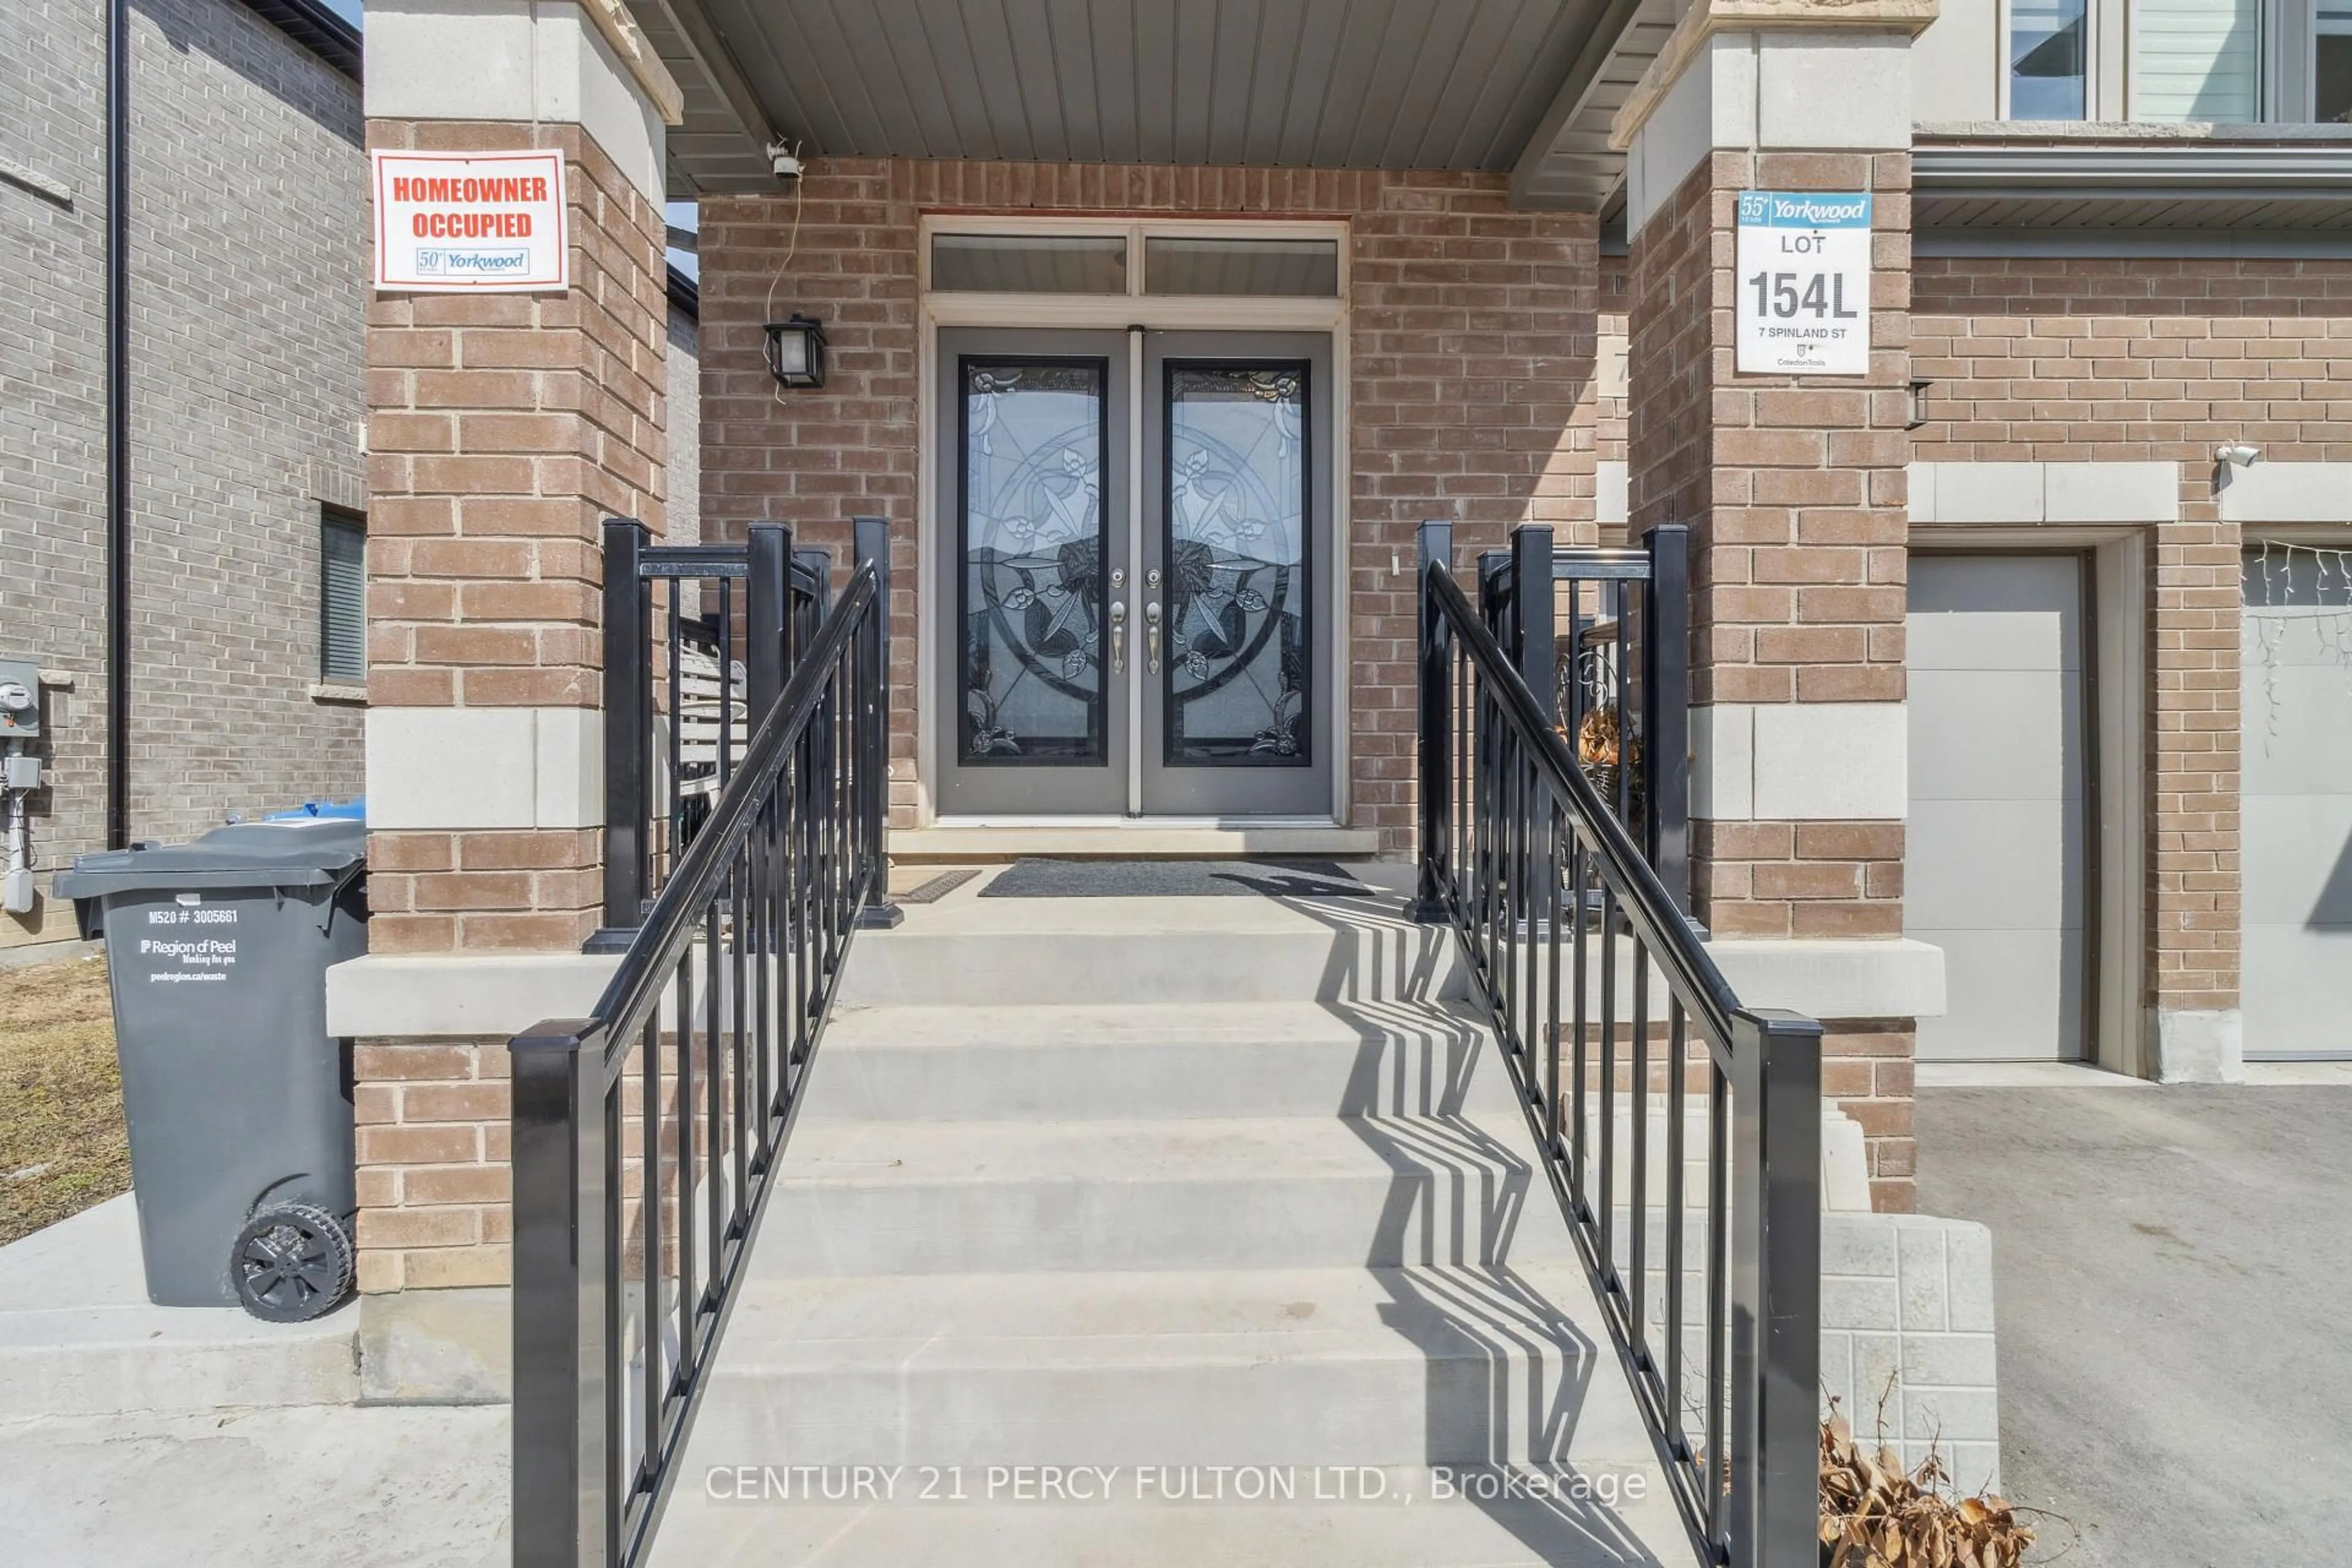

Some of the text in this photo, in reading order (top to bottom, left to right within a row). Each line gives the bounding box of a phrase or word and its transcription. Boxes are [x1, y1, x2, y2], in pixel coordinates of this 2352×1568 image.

[393, 177, 548, 202] HOMEOWNER
[1774, 200, 1866, 224] Yorkwood
[413, 213, 532, 238] OCCUPIED
[1782, 235, 1826, 254] LOT
[449, 254, 524, 271] Yorkwood
[1749, 271, 1858, 318] 154L
[1758, 327, 1847, 339] 7 SPINLAND ST
[149, 911, 176, 924] M520
[179, 910, 190, 923] #
[152, 940, 236, 956] Region of Peel
